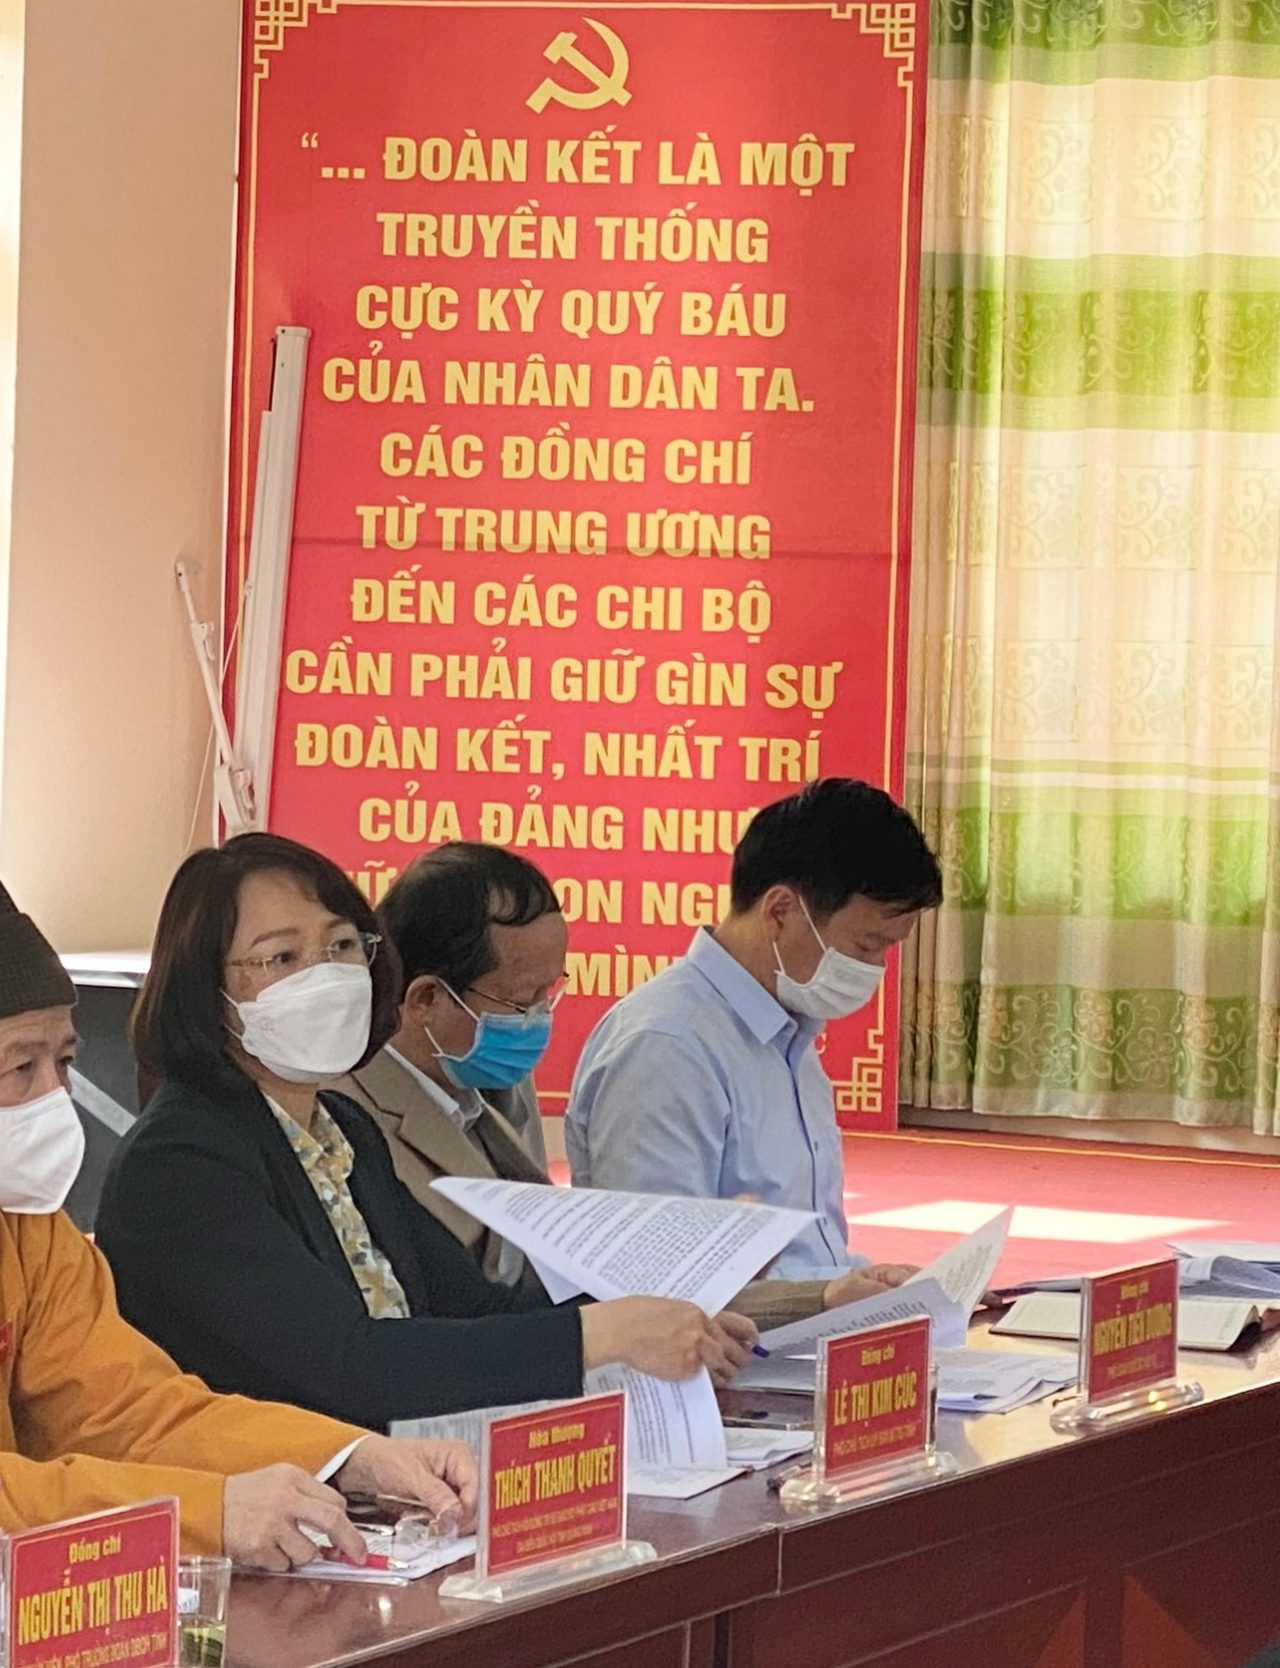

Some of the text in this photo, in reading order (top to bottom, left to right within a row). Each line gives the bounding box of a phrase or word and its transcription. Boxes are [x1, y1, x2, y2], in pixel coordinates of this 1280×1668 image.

[383, 129, 528, 182] ĐOÀN
[546, 124, 642, 184] KẾT
[658, 132, 721, 186] LÀ
[739, 133, 855, 196] MỘT
[376, 199, 769, 263] TRUYỀN THỐNG
[356, 279, 786, 339] CỰC KỲ QUÝ BÁU
[323, 340, 814, 412] CỦA NHÂN DÂN TA.
[380, 421, 753, 485] CÁC ĐỒNG CHÍ
[356, 495, 771, 559] TỪ TRUNG ƯƠNG
[350, 564, 771, 643] ĐẾN CÁC CHI BỘ
[286, 636, 843, 719] CẦN PHẢI GIỮ GÌN SỰ
[294, 714, 821, 783] ĐOÀN KẾT, NHẤT TRÍ
[359, 780, 462, 844] CỦA
[479, 784, 624, 850] ĐẢNG
[552, 878, 623, 923] ON
[565, 944, 686, 996] MÌN
[851, 1383, 870, 1427] THỊ
[872, 1377, 893, 1416] KIM
[495, 1432, 617, 1510] THÍCH THANH QUYẾT
[103, 1532, 122, 1555] chí
[18, 1555, 168, 1646] NGUYỄN THỊ THU HÀ
